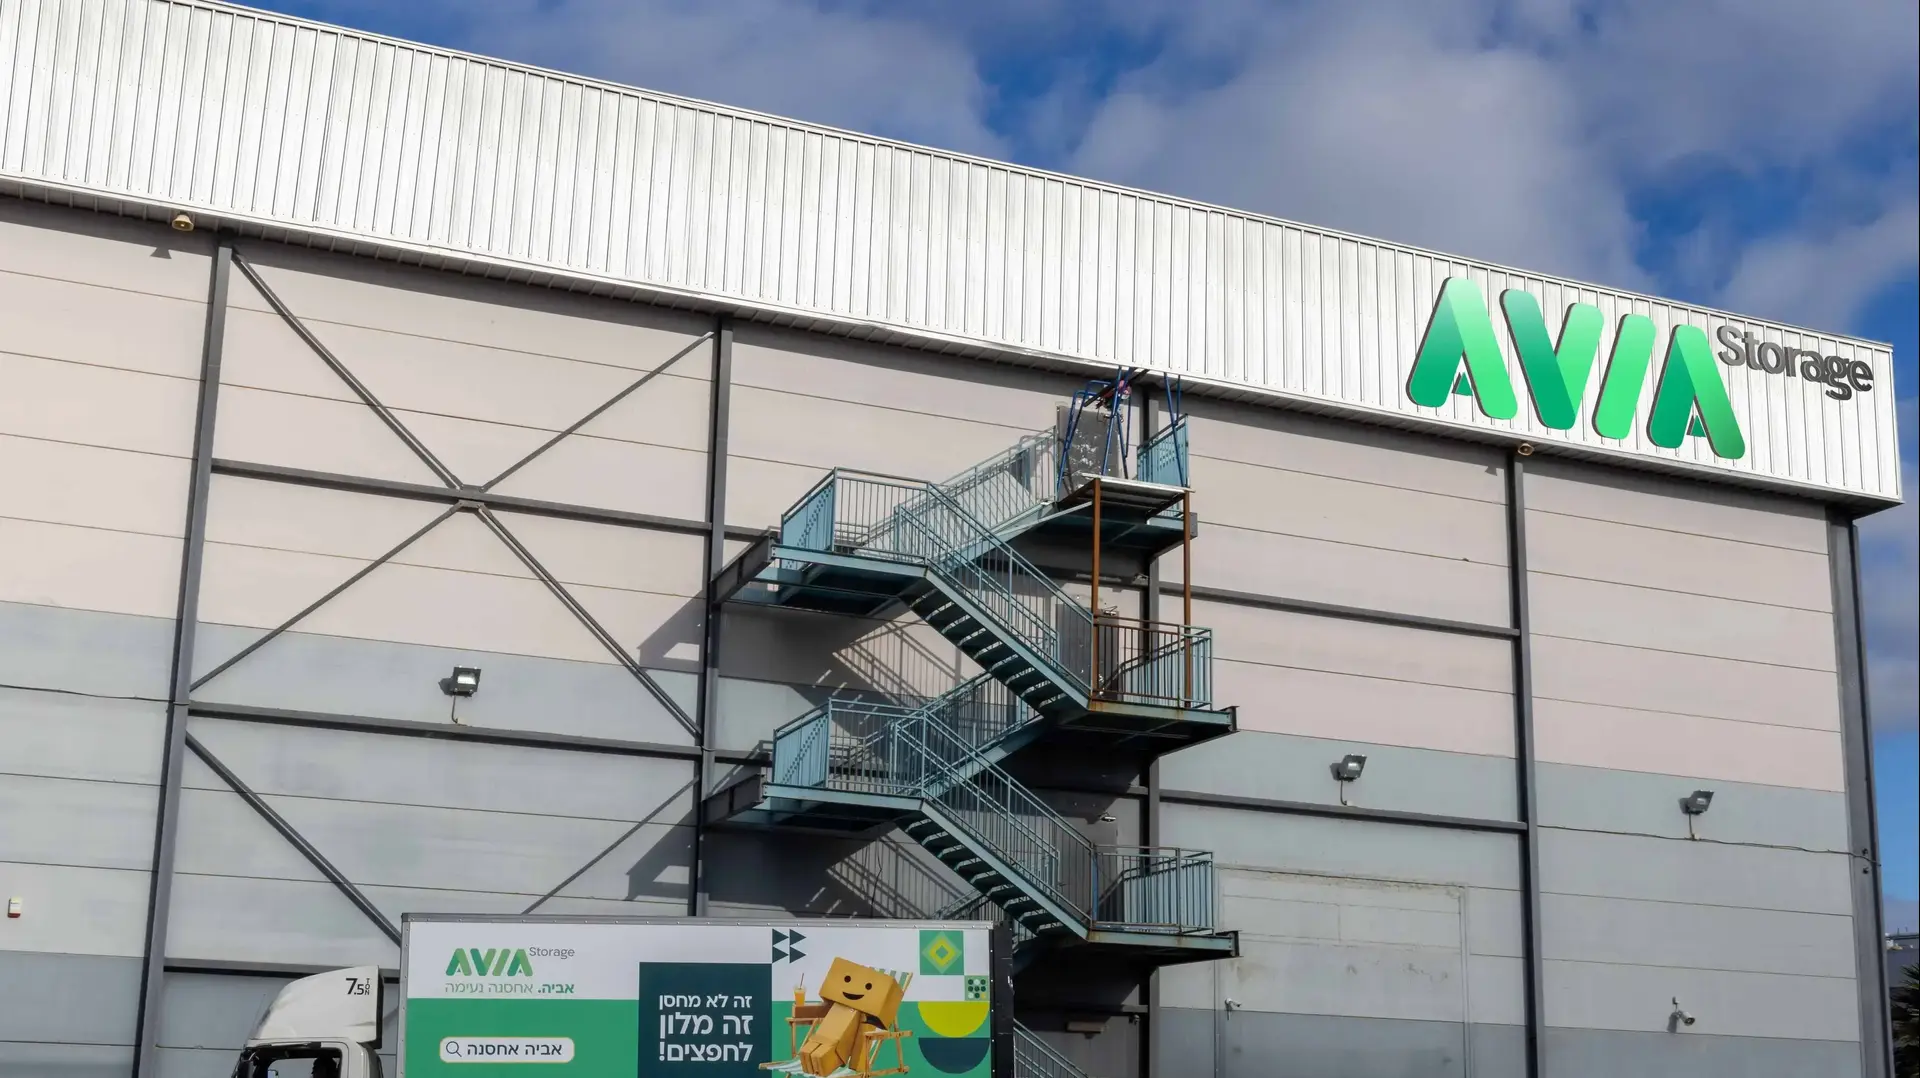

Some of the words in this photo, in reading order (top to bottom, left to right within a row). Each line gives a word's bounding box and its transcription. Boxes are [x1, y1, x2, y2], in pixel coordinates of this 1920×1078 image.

[1406, 277, 1746, 460] AVIA
[1717, 325, 1874, 400] Storage
[445, 948, 534, 977] AVIA
[529, 946, 575, 960] Storage
[345, 977, 365, 996] 7.5
[445, 982, 484, 994] נעימה
[488, 983, 534, 993] אחסנה
[537, 983, 575, 994] אביה.
[659, 994, 702, 1011] מחסן
[705, 993, 729, 1008] לא
[733, 995, 753, 1009] זה
[660, 1012, 714, 1039] מלון
[722, 1015, 754, 1035] זה
[467, 1044, 519, 1055] אחסנה
[525, 1044, 562, 1055] אביה
[658, 1041, 754, 1062] לחפצים!
